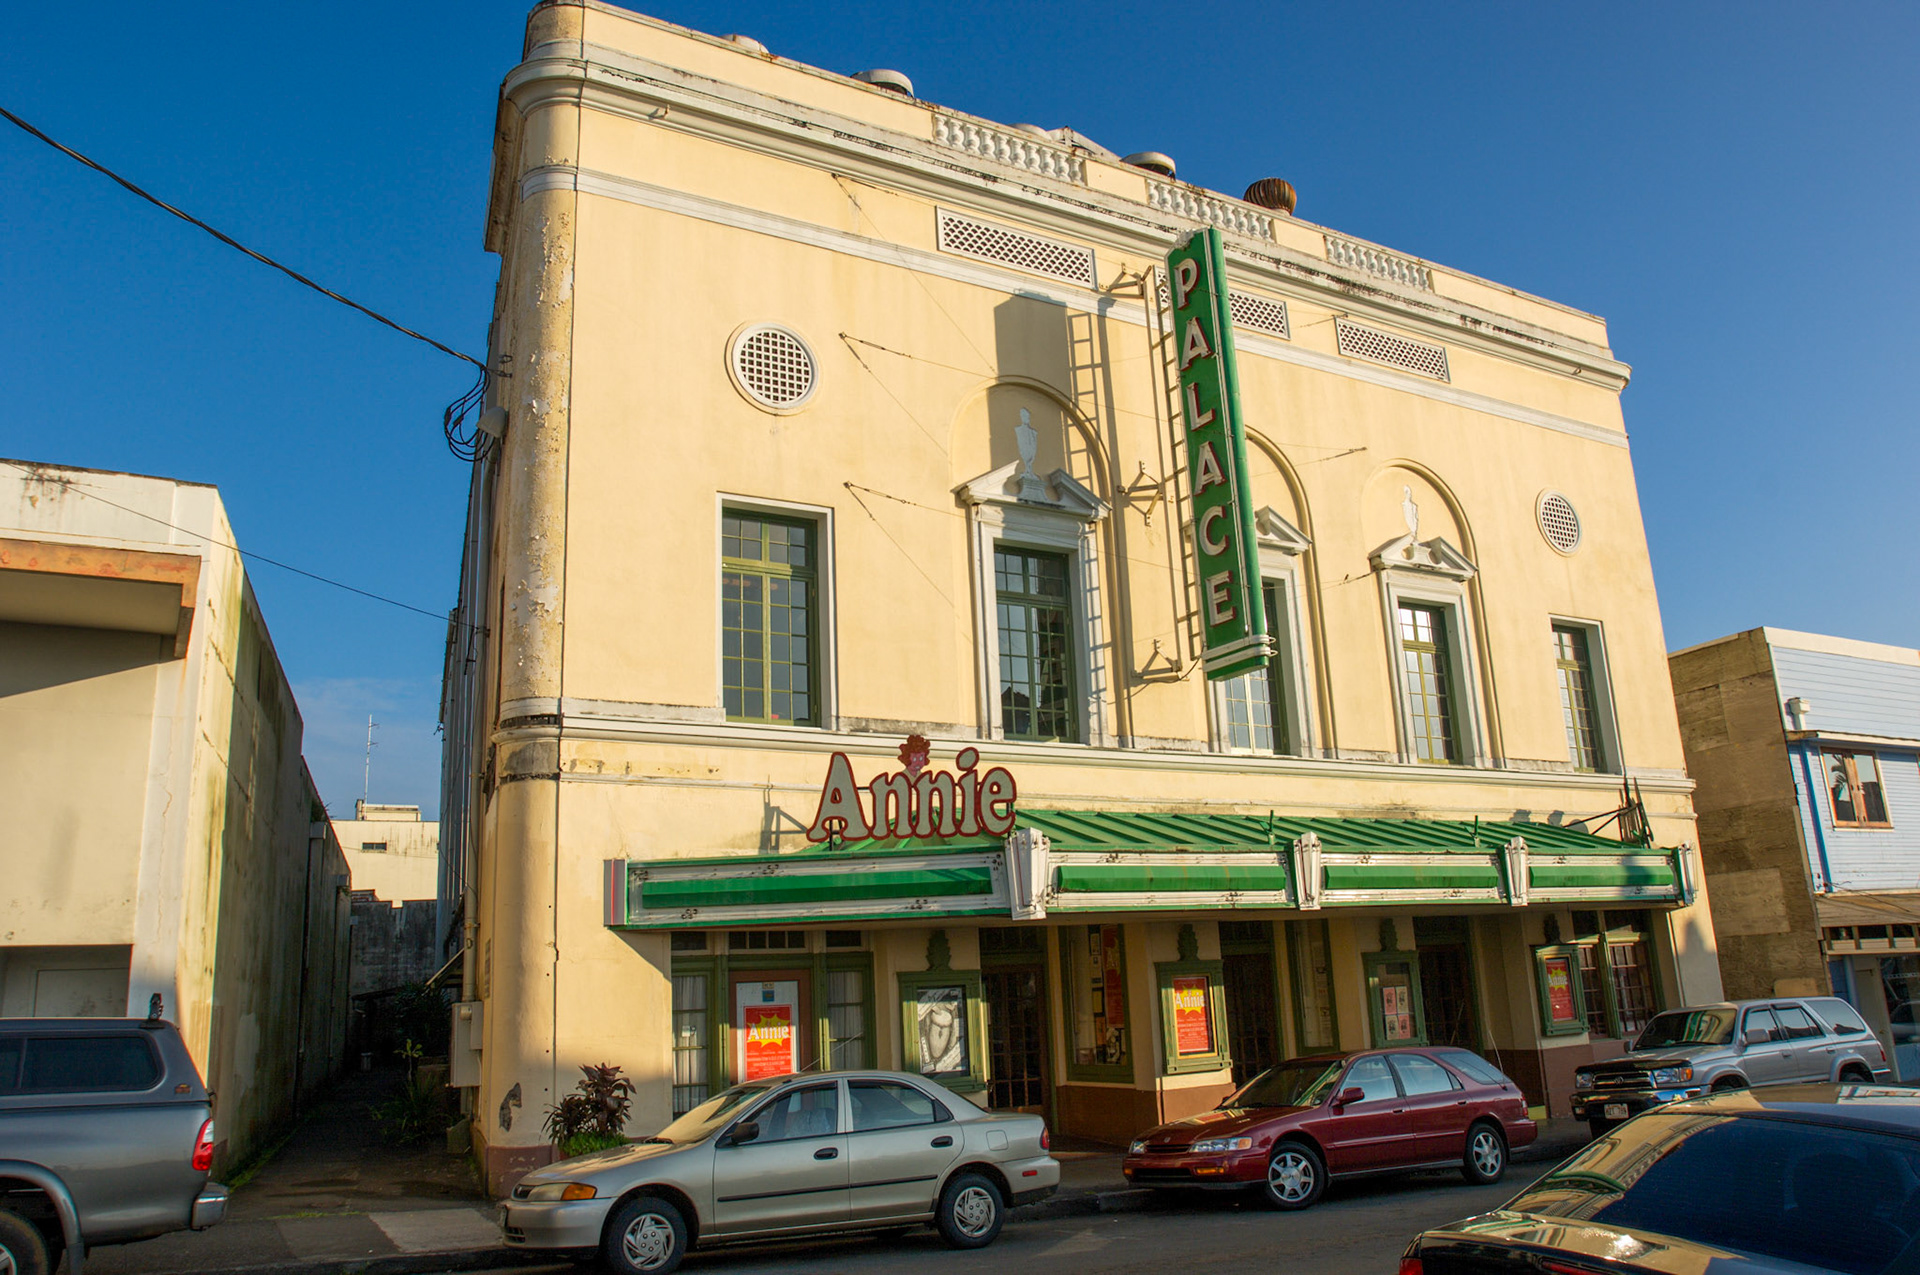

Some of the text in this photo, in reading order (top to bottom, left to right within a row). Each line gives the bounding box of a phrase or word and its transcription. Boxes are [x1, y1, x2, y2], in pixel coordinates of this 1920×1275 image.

[1173, 257, 1236, 628] PALACE
[806, 746, 1017, 843] Annie
[1175, 992, 1206, 1009] Annie
[747, 1022, 790, 1040] Annie
